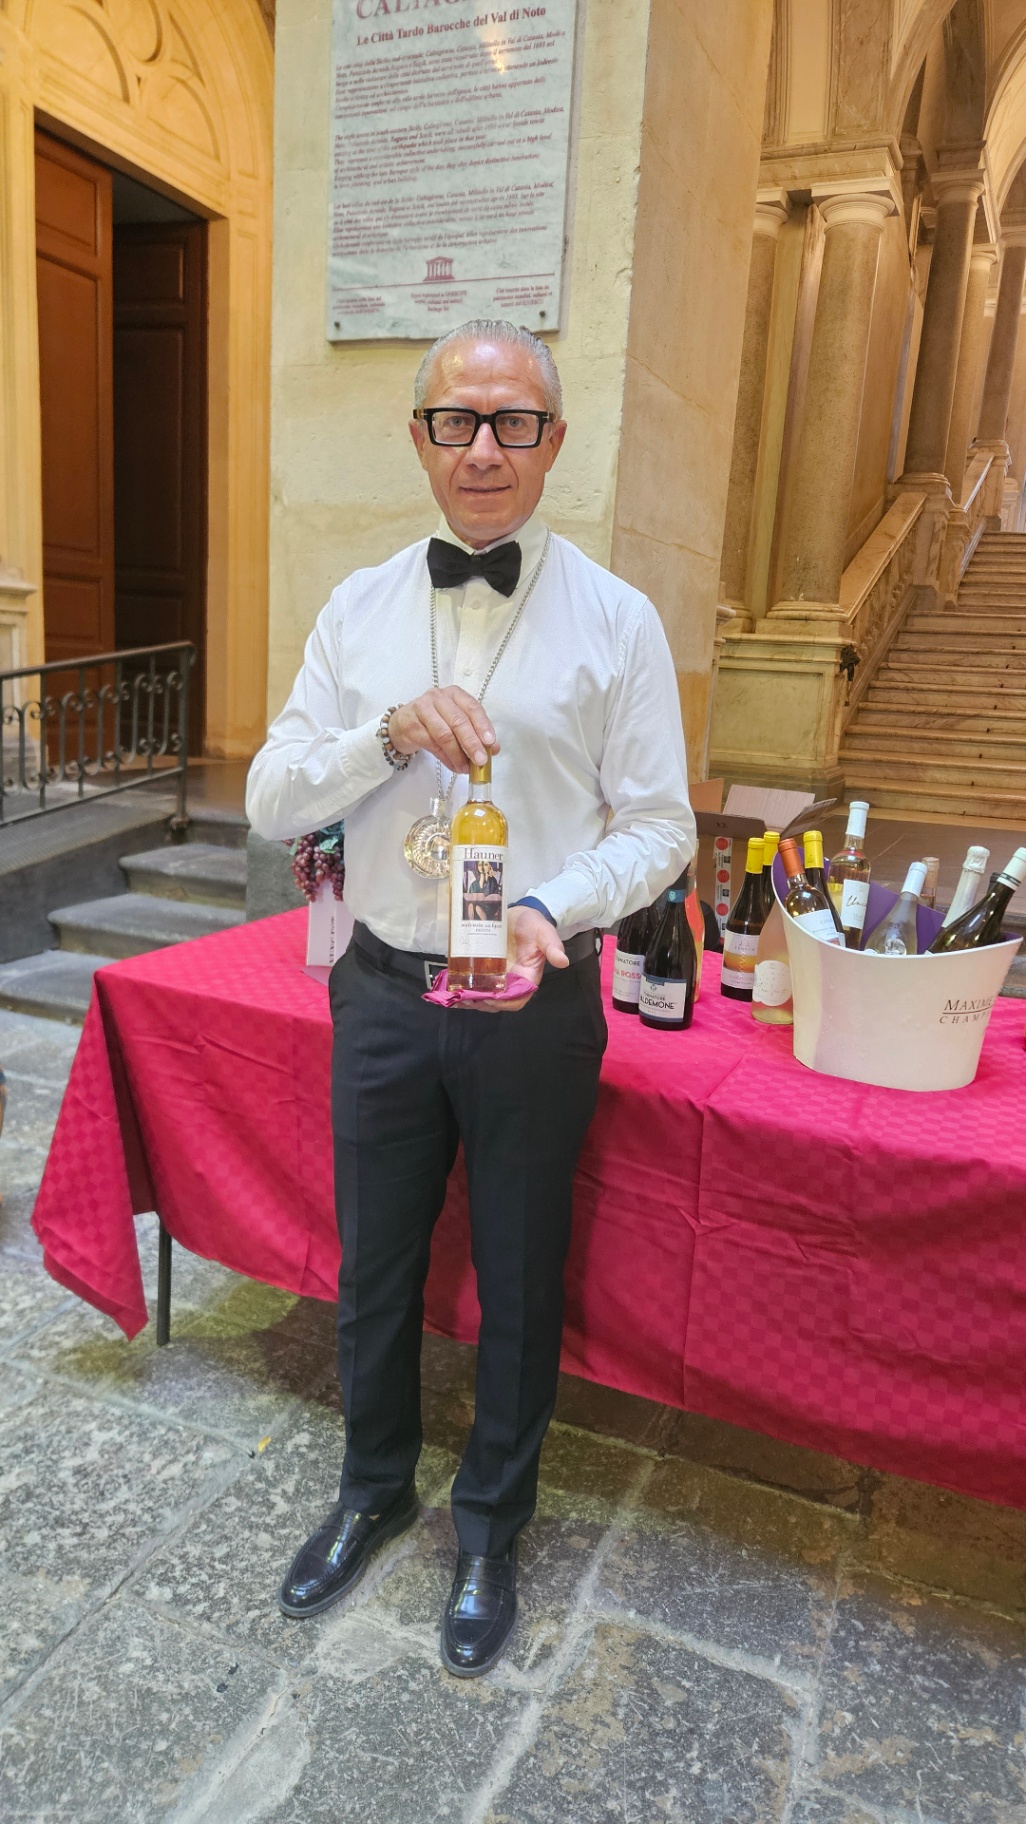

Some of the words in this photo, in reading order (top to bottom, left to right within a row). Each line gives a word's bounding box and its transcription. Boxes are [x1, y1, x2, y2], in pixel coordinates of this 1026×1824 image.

[356, 33, 368, 45] Le
[370, 29, 393, 43] Città
[395, 24, 424, 39] Tardo
[426, 17, 470, 34] Barocche
[473, 14, 487, 27] del
[490, 11, 507, 24] Val
[509, 9, 519, 21] di
[521, 4, 546, 19] Noto
[464, 847, 503, 861] Hauner
[620, 970, 642, 980] ROSS
[641, 996, 676, 1010] ALDEMONE
